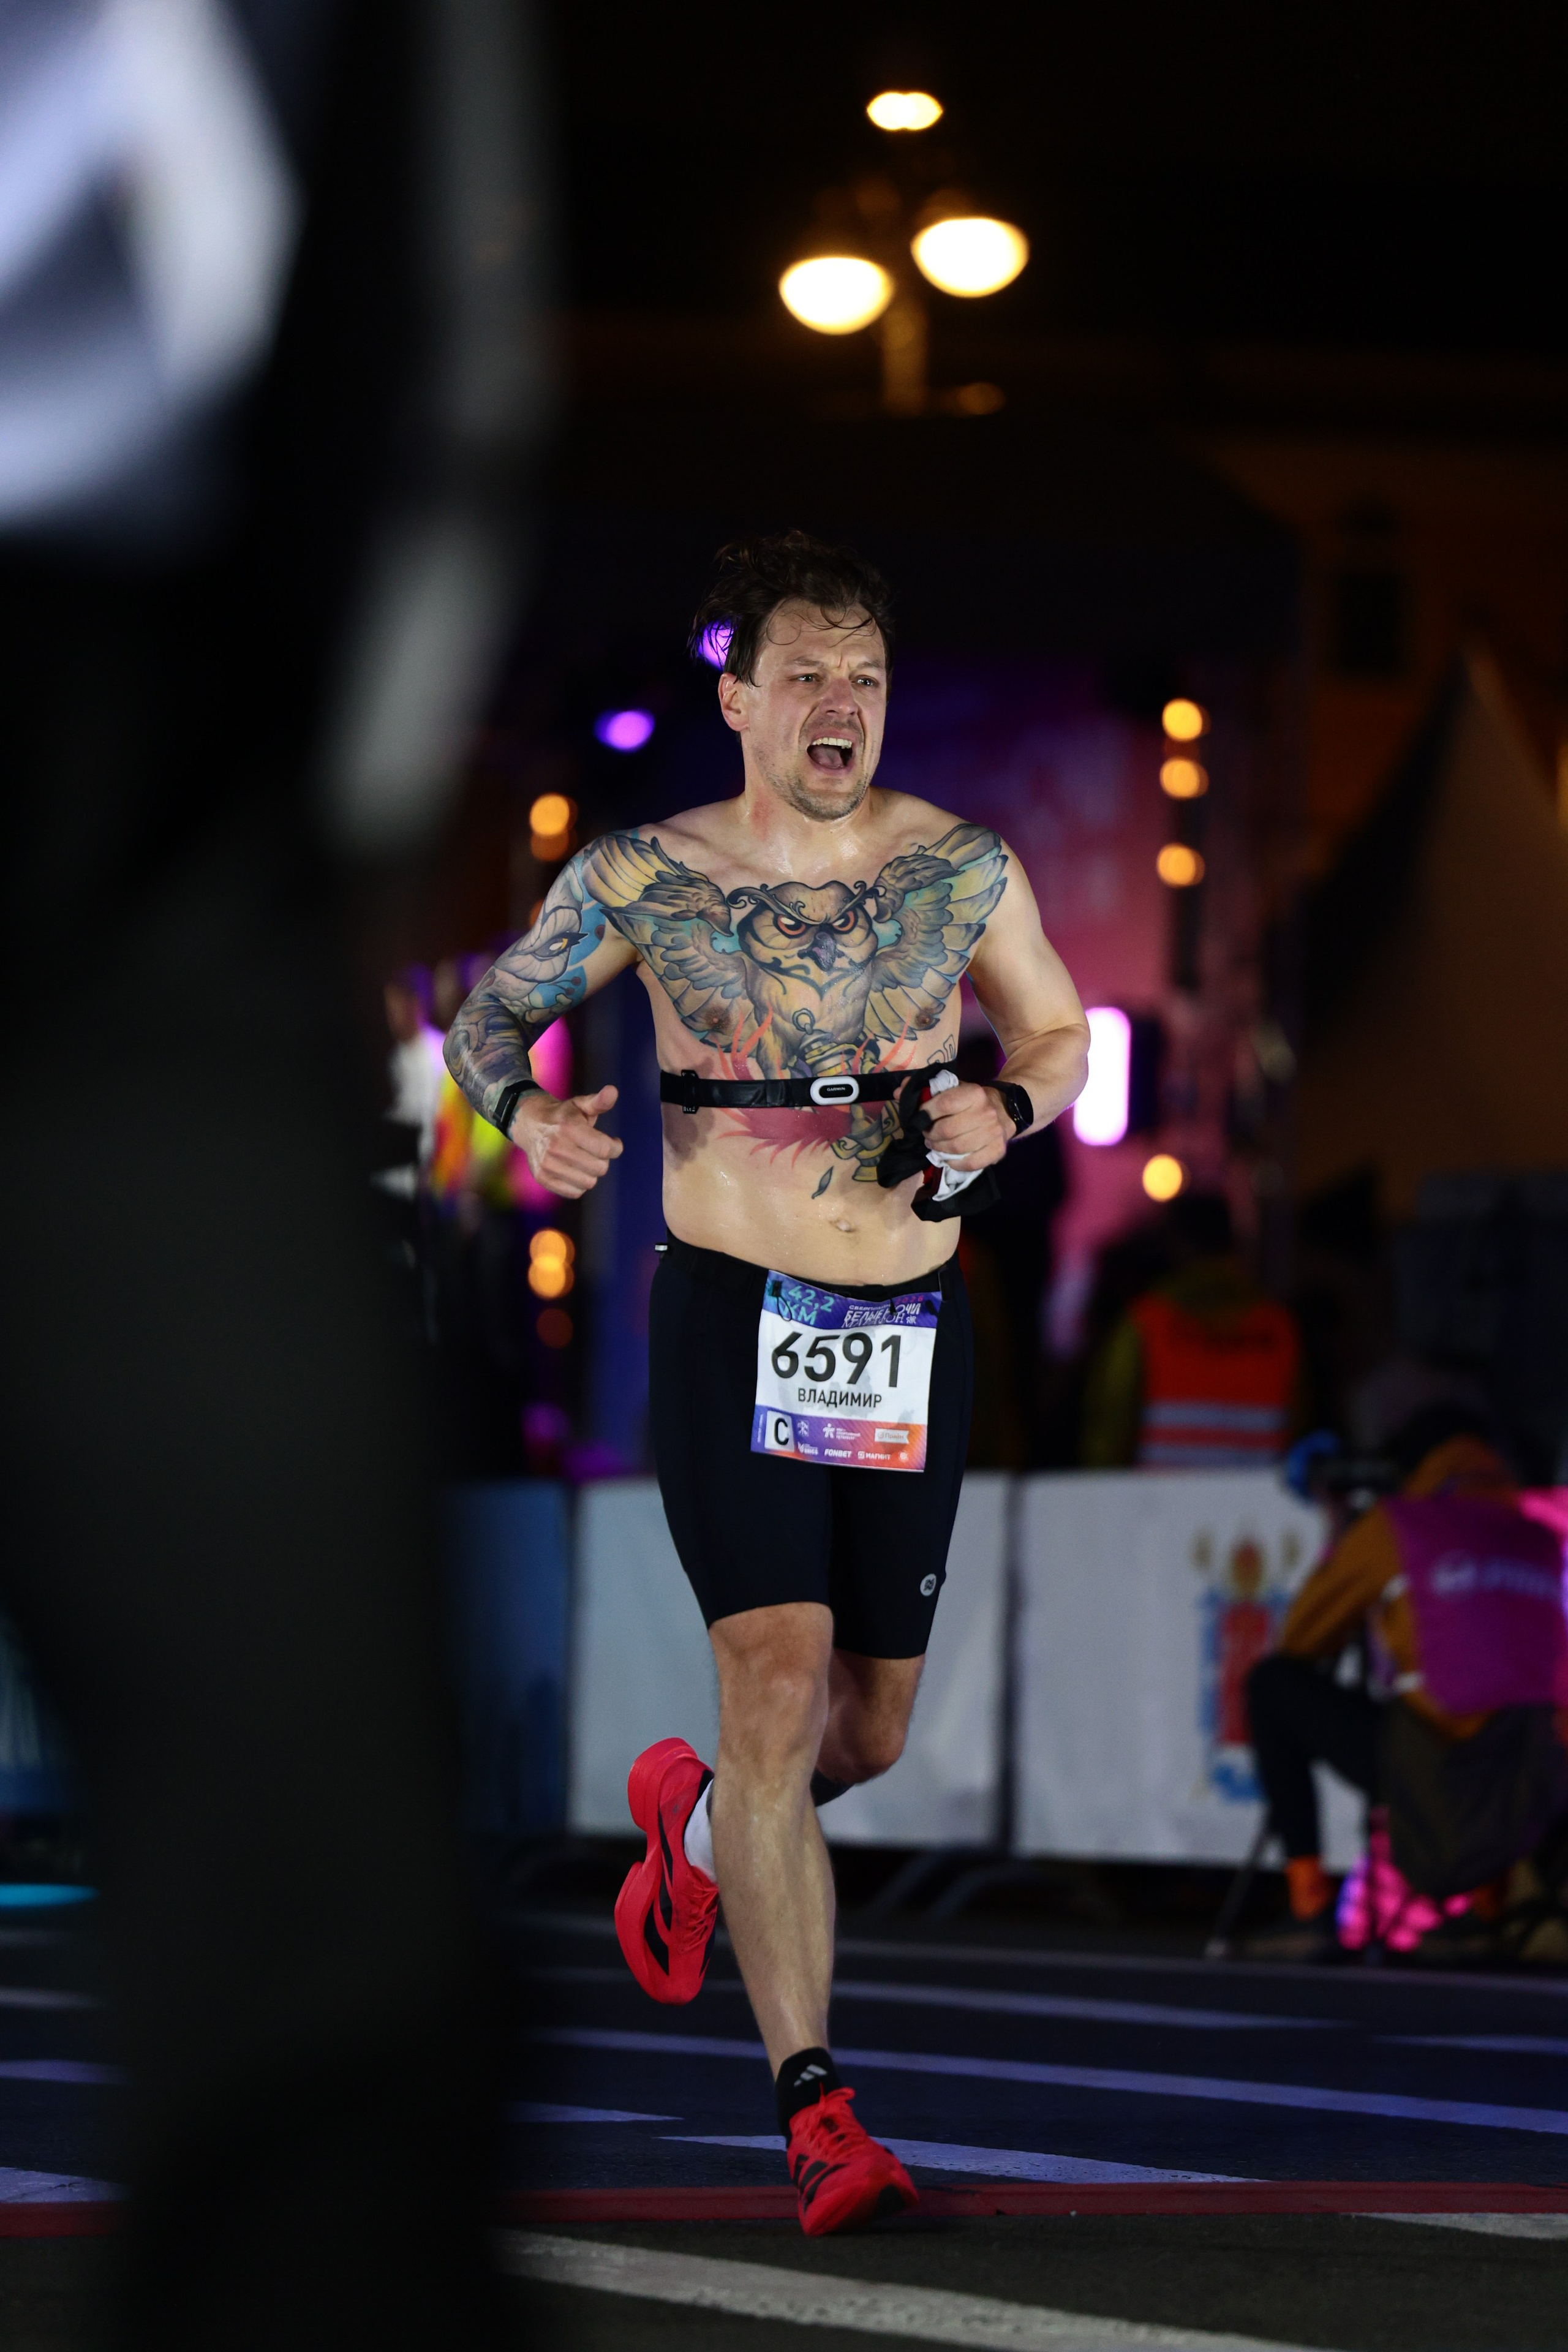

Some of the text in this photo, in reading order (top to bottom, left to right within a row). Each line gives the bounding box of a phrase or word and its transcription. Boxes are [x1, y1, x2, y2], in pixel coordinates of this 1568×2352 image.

[788, 1286, 834, 1312] 42,2
[772, 1331, 901, 1388] 6591
[798, 1388, 882, 1408] ВЛАДИМИР
[774, 1418, 789, 1446] C
[824, 1449, 852, 1458] FONBET
